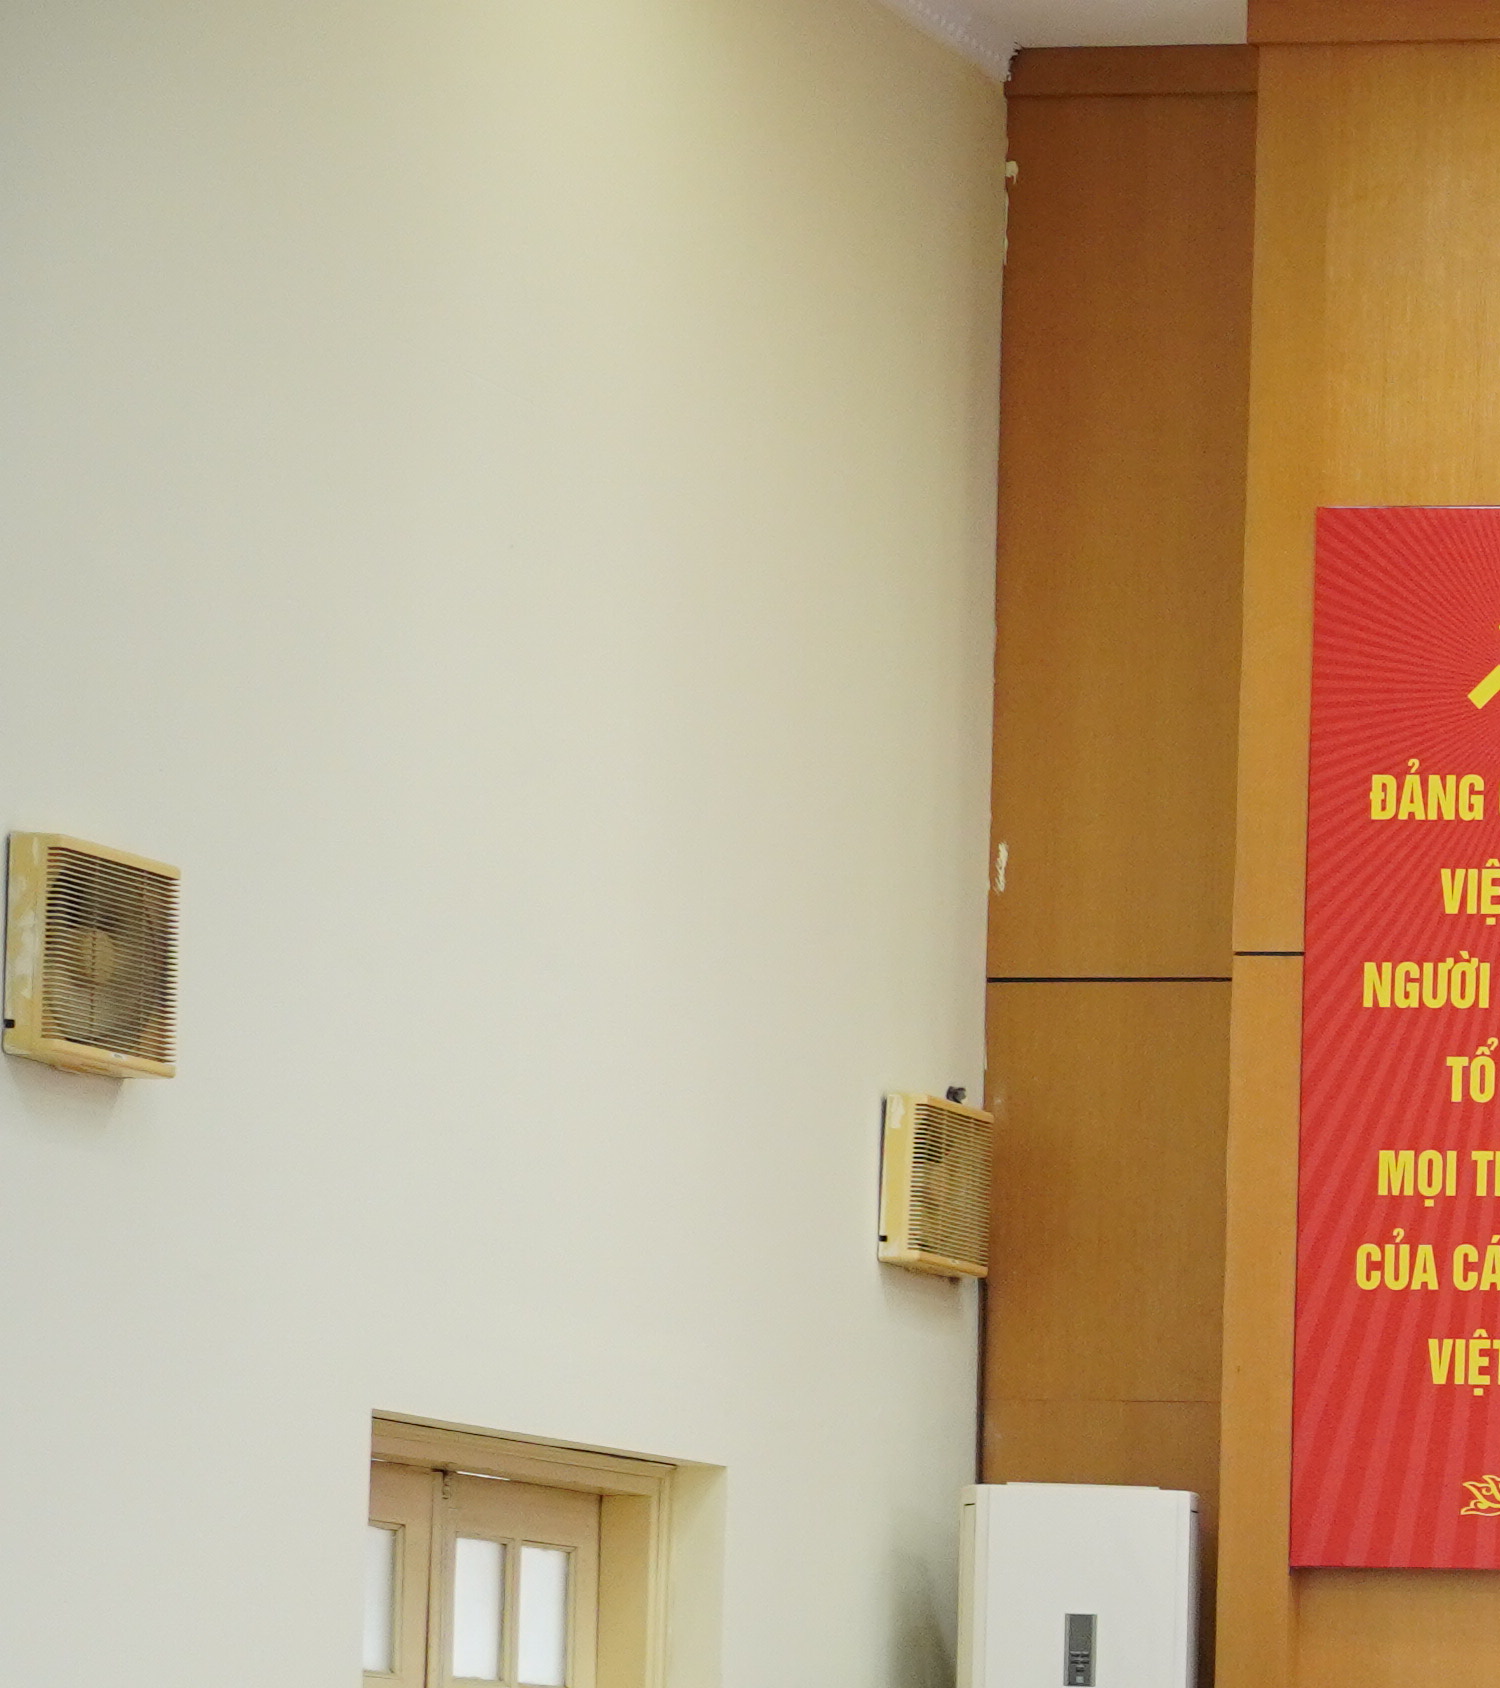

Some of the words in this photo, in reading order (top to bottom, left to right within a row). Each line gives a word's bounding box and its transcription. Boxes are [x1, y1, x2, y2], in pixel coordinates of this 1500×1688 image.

[1370, 759, 1484, 820] ĐẢNG
[1363, 951, 1489, 1008] NGƯỜI
[1447, 1038, 1497, 1102] TỔ
[1378, 1150, 1456, 1206] MỌI
[1356, 1229, 1438, 1290] CỦA
